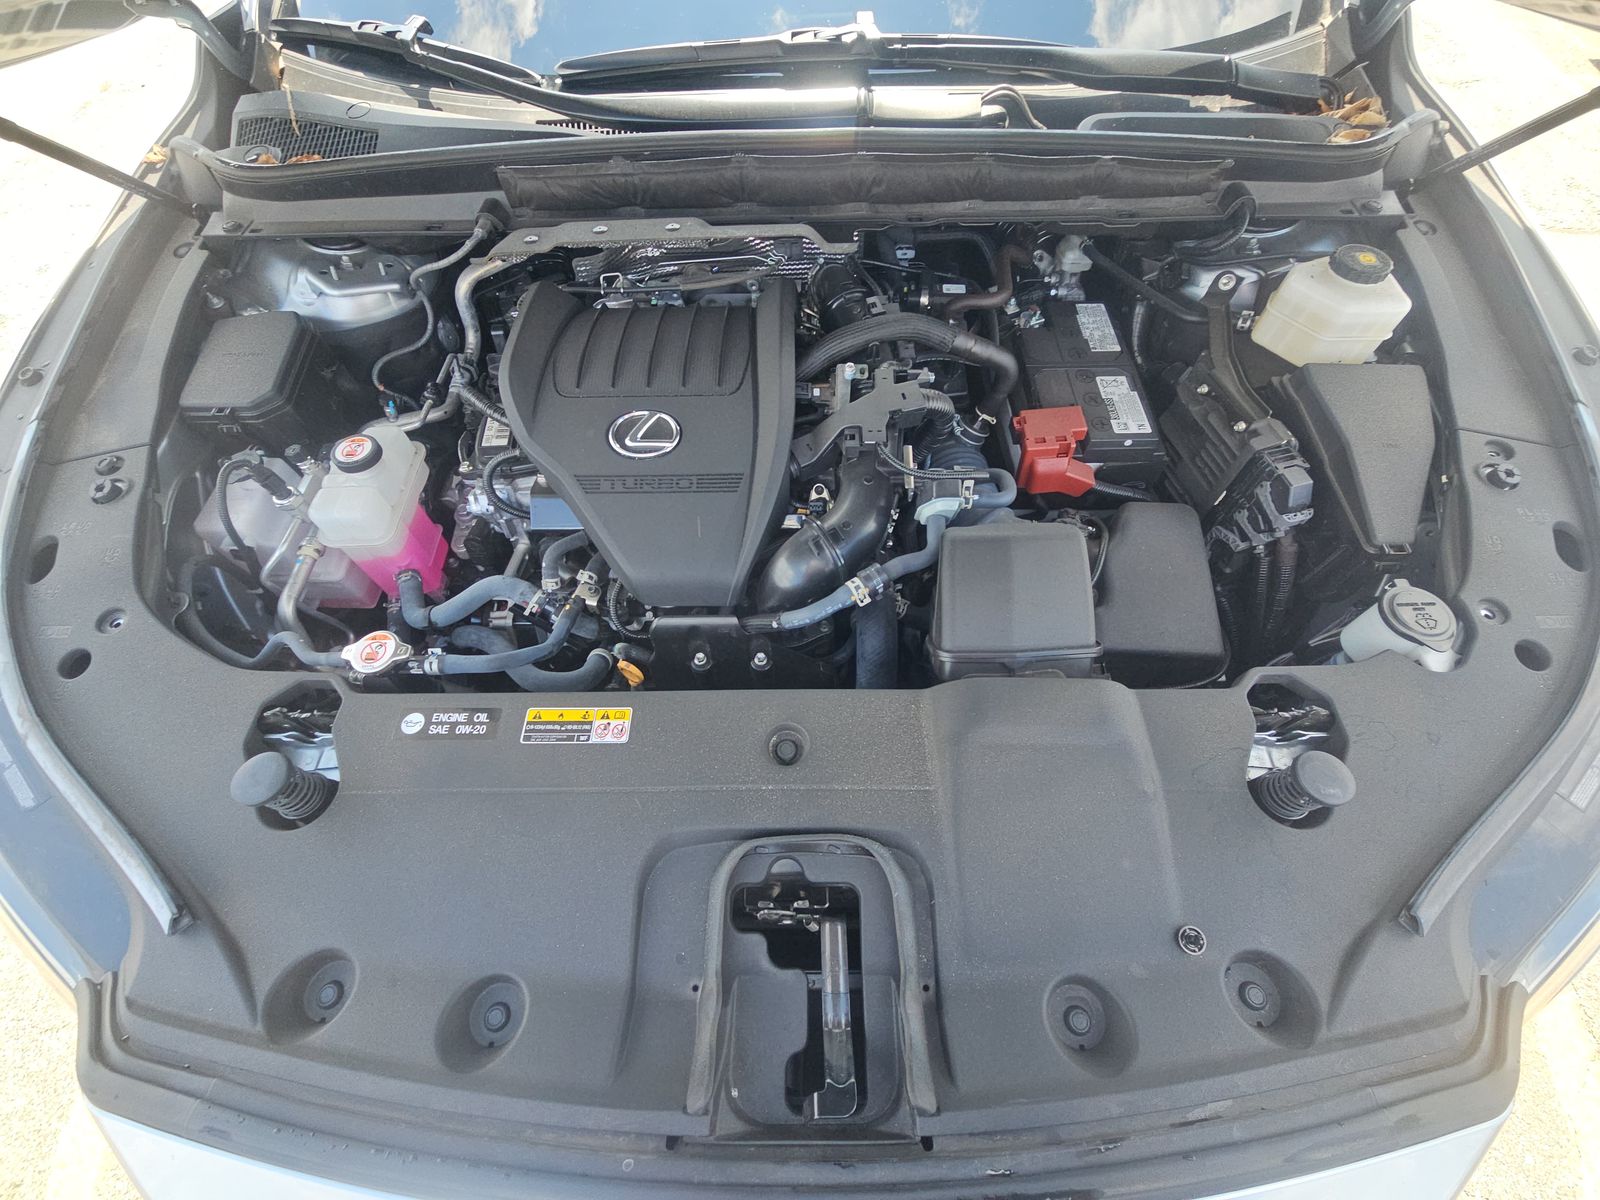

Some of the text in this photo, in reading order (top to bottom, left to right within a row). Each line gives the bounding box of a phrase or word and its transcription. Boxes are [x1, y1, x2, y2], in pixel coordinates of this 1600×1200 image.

[602, 478, 695, 490] TURBO
[431, 713, 490, 722] ENGINE OIL
[428, 725, 487, 734] SAE 0W-20
